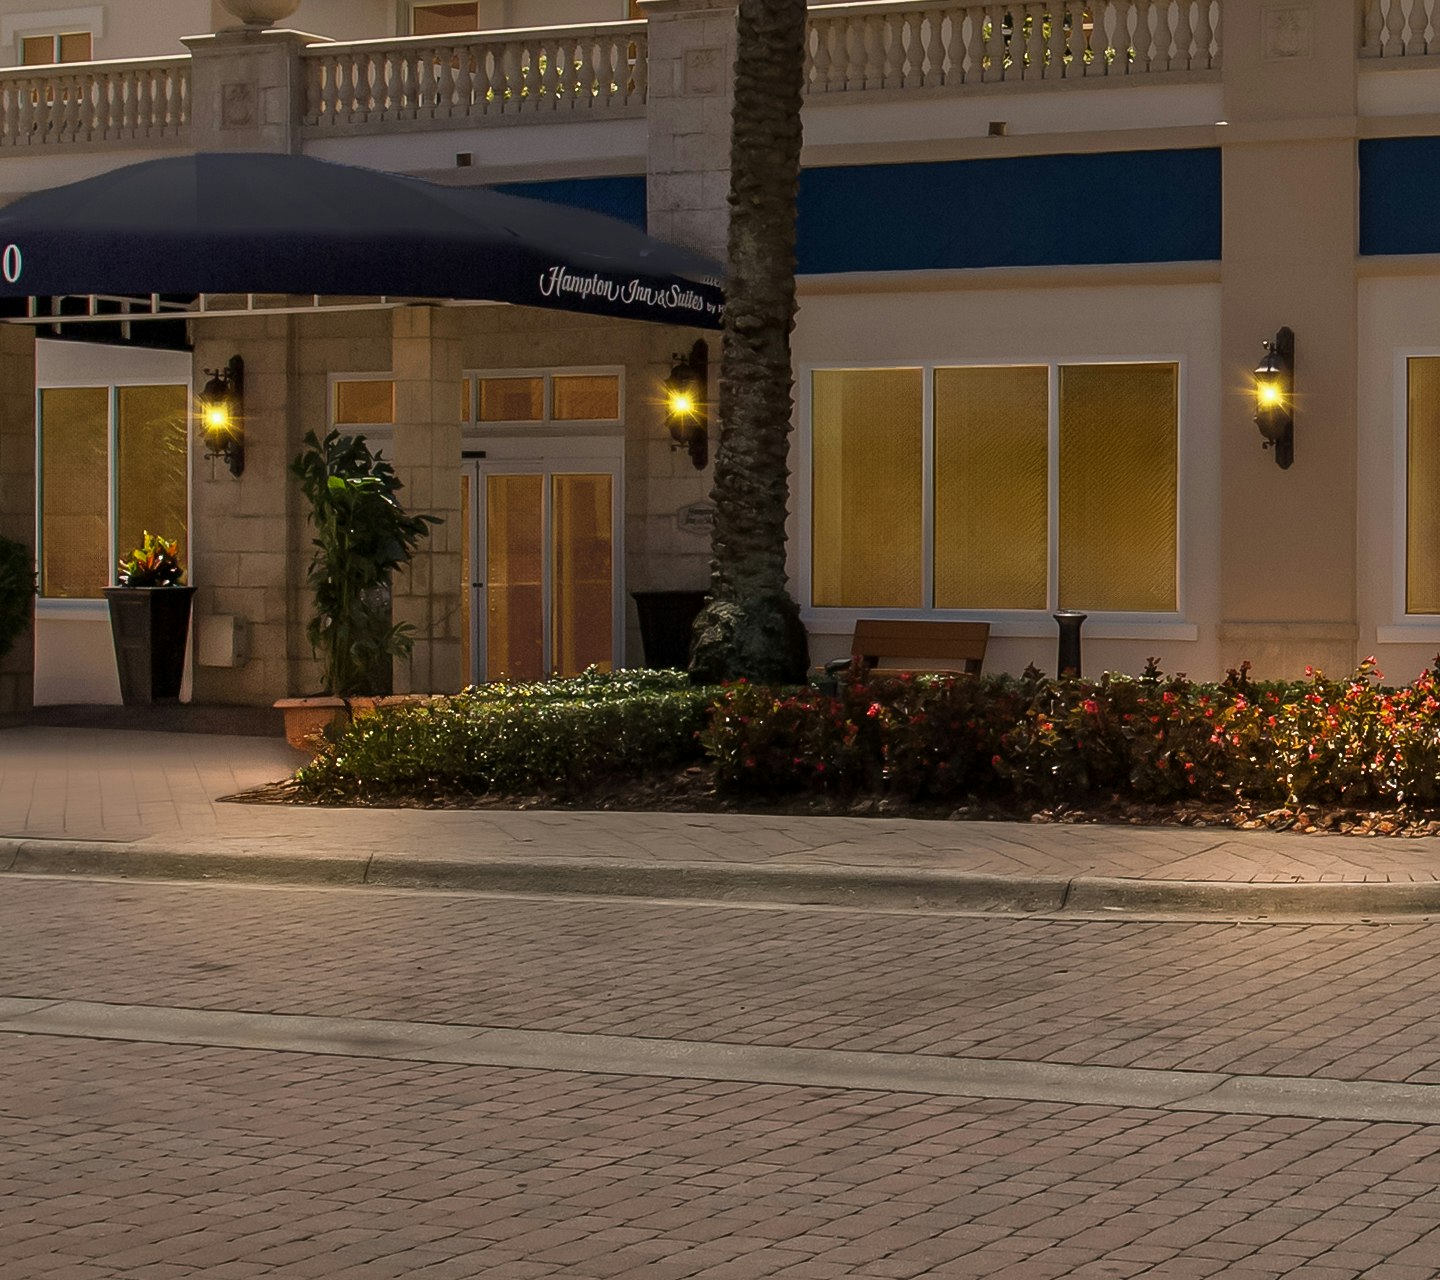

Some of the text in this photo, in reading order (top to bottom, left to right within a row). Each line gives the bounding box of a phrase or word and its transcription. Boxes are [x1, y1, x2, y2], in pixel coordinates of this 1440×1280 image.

[539, 266, 619, 301] Hampton
[621, 279, 658, 306] Inn
[666, 284, 704, 311] Suites
[706, 303, 716, 314] by
